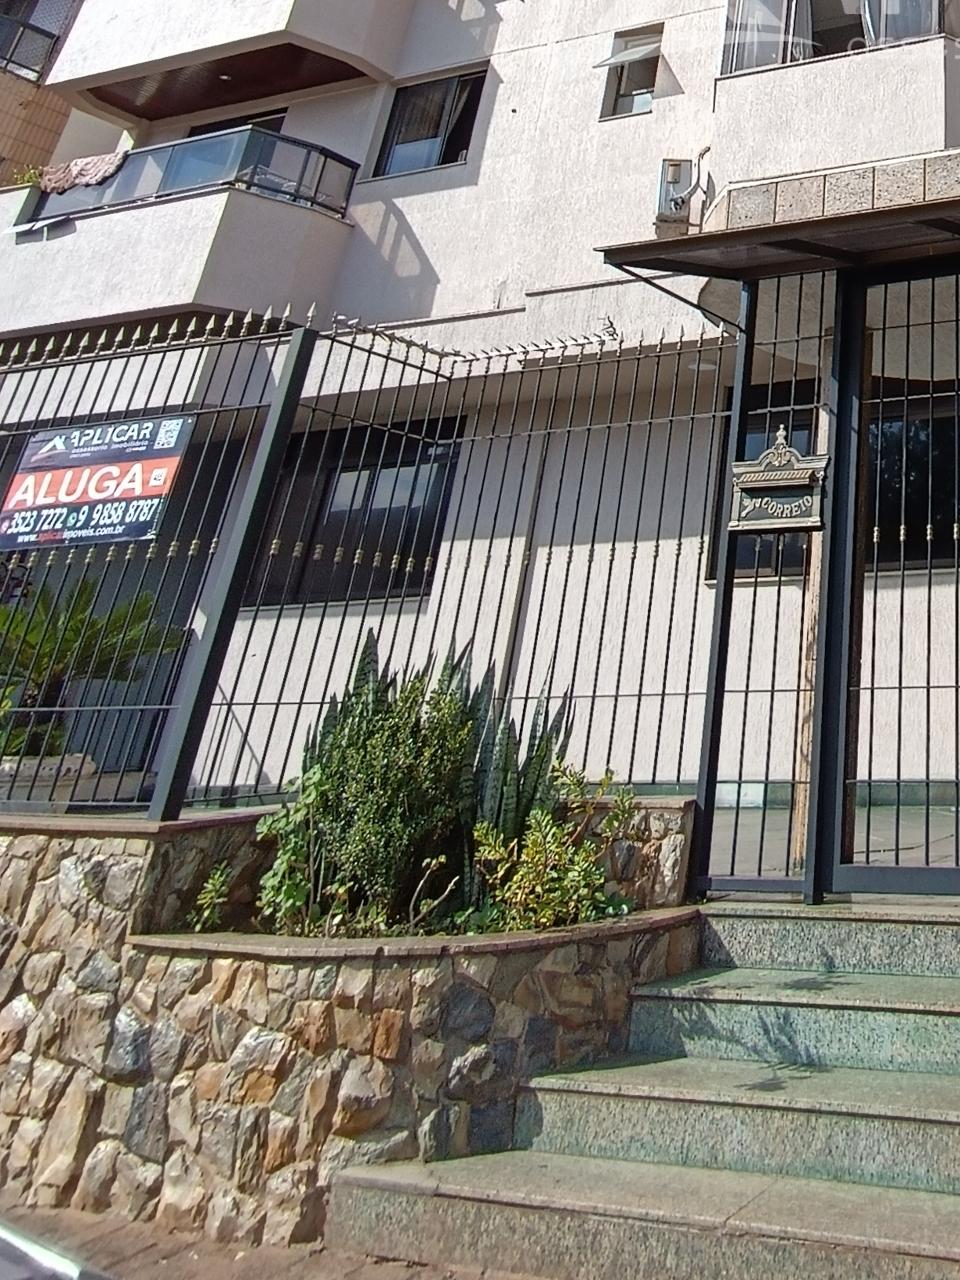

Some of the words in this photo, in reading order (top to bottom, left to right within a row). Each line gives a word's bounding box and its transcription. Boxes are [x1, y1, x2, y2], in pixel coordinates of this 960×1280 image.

[8, 463, 144, 510] ALUGA
[761, 495, 813, 518] CORREIO
[35, 507, 68, 531] 7272
